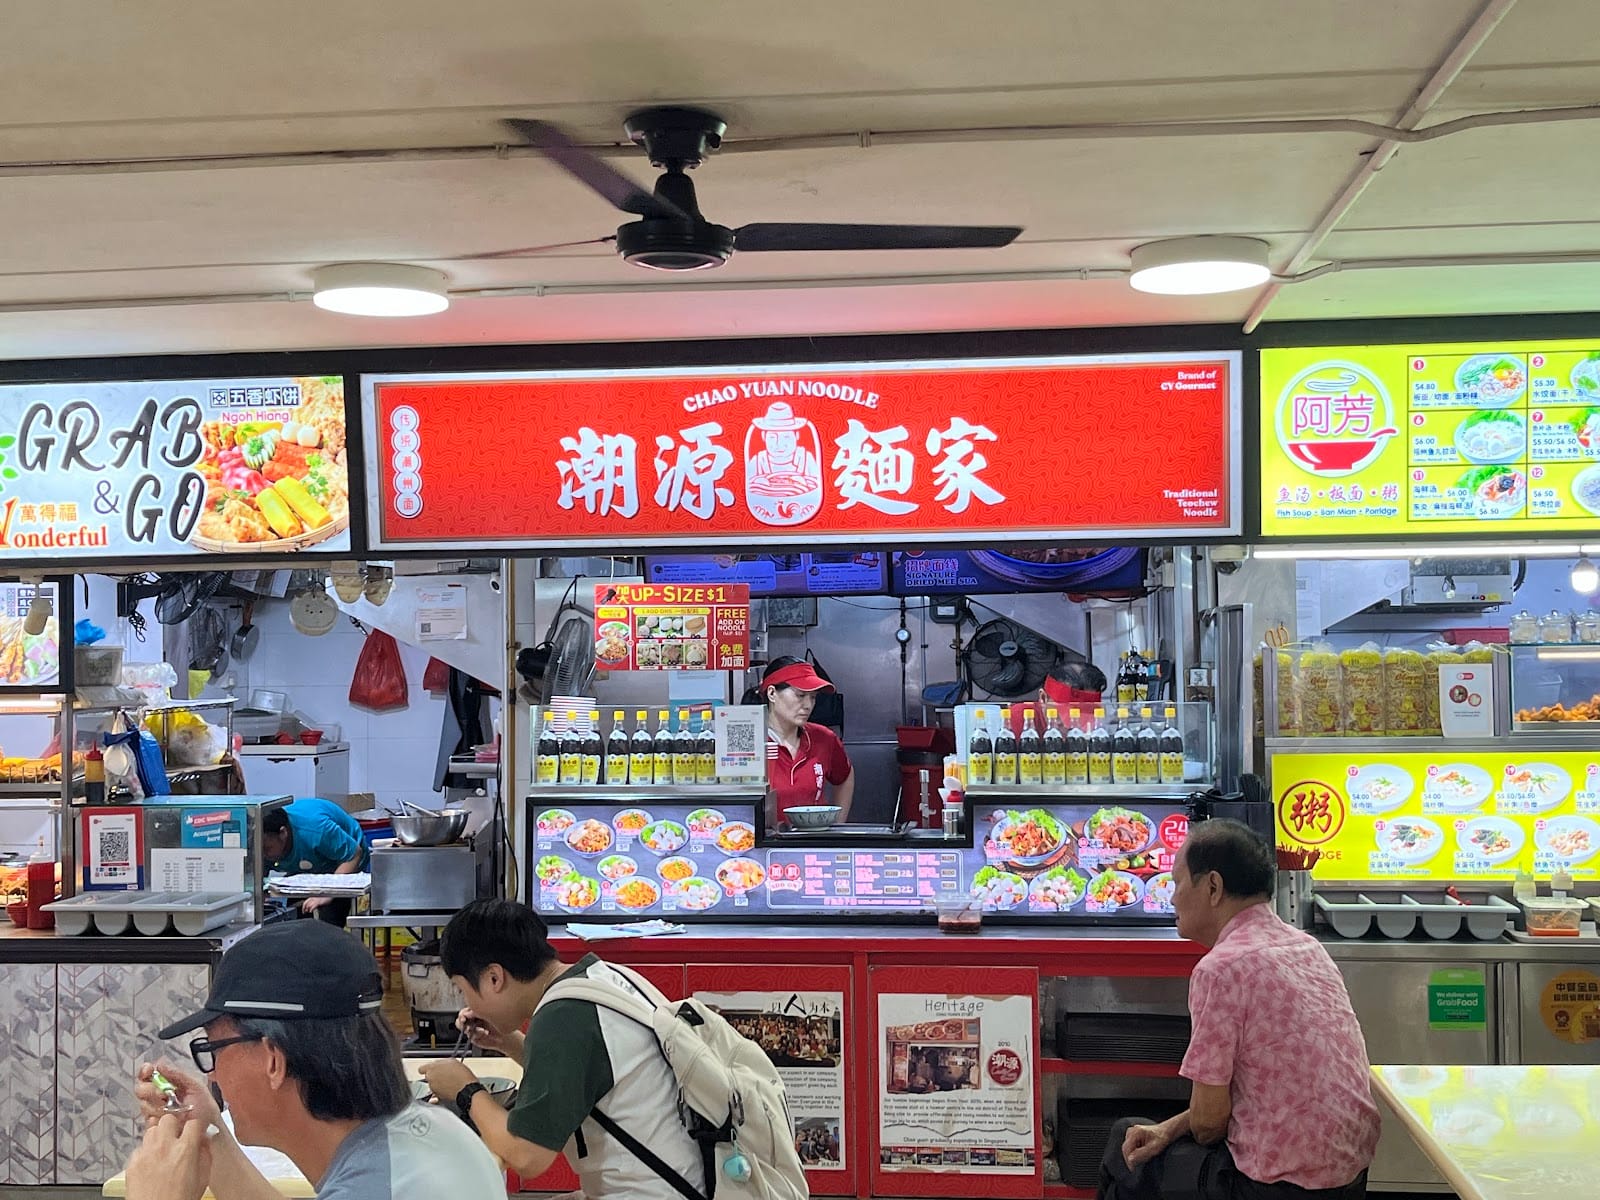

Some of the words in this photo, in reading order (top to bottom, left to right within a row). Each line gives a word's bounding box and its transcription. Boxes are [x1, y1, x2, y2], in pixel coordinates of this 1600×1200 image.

[1177, 371, 1205, 380] Brand
[1206, 370, 1217, 380] of
[1160, 382, 1174, 391] CY
[1175, 382, 1217, 391] Gourmet
[229, 387, 300, 407] 五香虾饼
[683, 388, 738, 413] CHAO
[739, 381, 797, 400] YUAN
[797, 381, 880, 411] NOODLE
[221, 410, 253, 423] Ngoh
[255, 410, 290, 424] Hiang
[1294, 394, 1374, 435] 阿芳
[18, 398, 203, 472] GRAB
[555, 421, 736, 520] 潮源
[831, 416, 1006, 516] 麵家
[1163, 489, 1218, 499] Traditional
[1276, 487, 1310, 504] 鱼汤
[1329, 485, 1363, 502] 板面
[1382, 485, 1398, 502] 粥
[94, 479, 120, 515] &
[125, 472, 205, 543] GO
[1177, 499, 1218, 508] Teochew
[20, 504, 77, 522] 萬得福
[1183, 507, 1218, 517] Noodle
[1292, 509, 1312, 518] Soup
[1337, 508, 1357, 516] Mian
[1365, 507, 1397, 517] Porridge
[905, 571, 957, 579] SIGNATURE
[905, 579, 936, 587] DRIED
[936, 578, 957, 586] MEE
[707, 586, 726, 603] $1
[717, 608, 747, 619] FREE
[1290, 789, 1333, 833] 粥
[925, 999, 985, 1013] Heritage
[1437, 998, 1479, 1007] GrabFood
